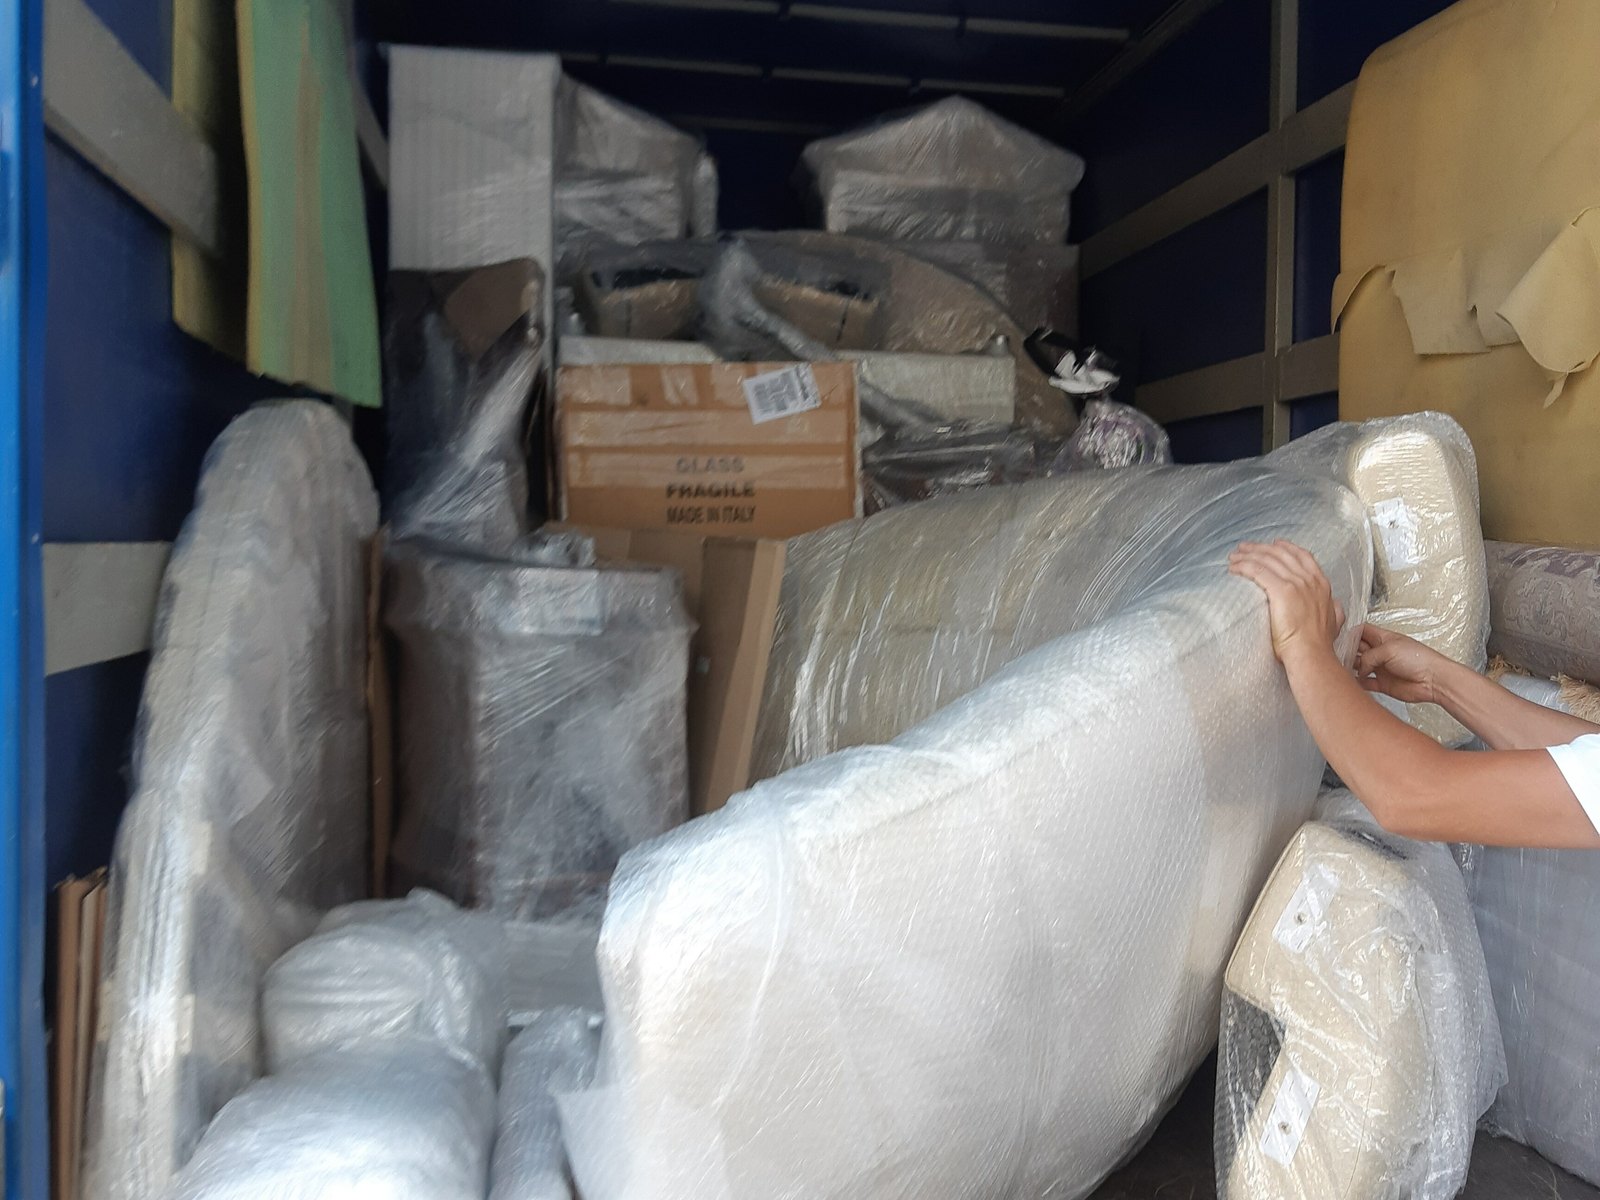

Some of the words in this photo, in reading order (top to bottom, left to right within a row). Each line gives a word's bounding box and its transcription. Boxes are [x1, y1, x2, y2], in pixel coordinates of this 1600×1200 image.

[676, 456, 744, 474] GLASS
[666, 482, 755, 498] FRAGILE
[667, 506, 704, 524] MADE
[706, 507, 720, 523] IN
[722, 505, 755, 523] ITALY
